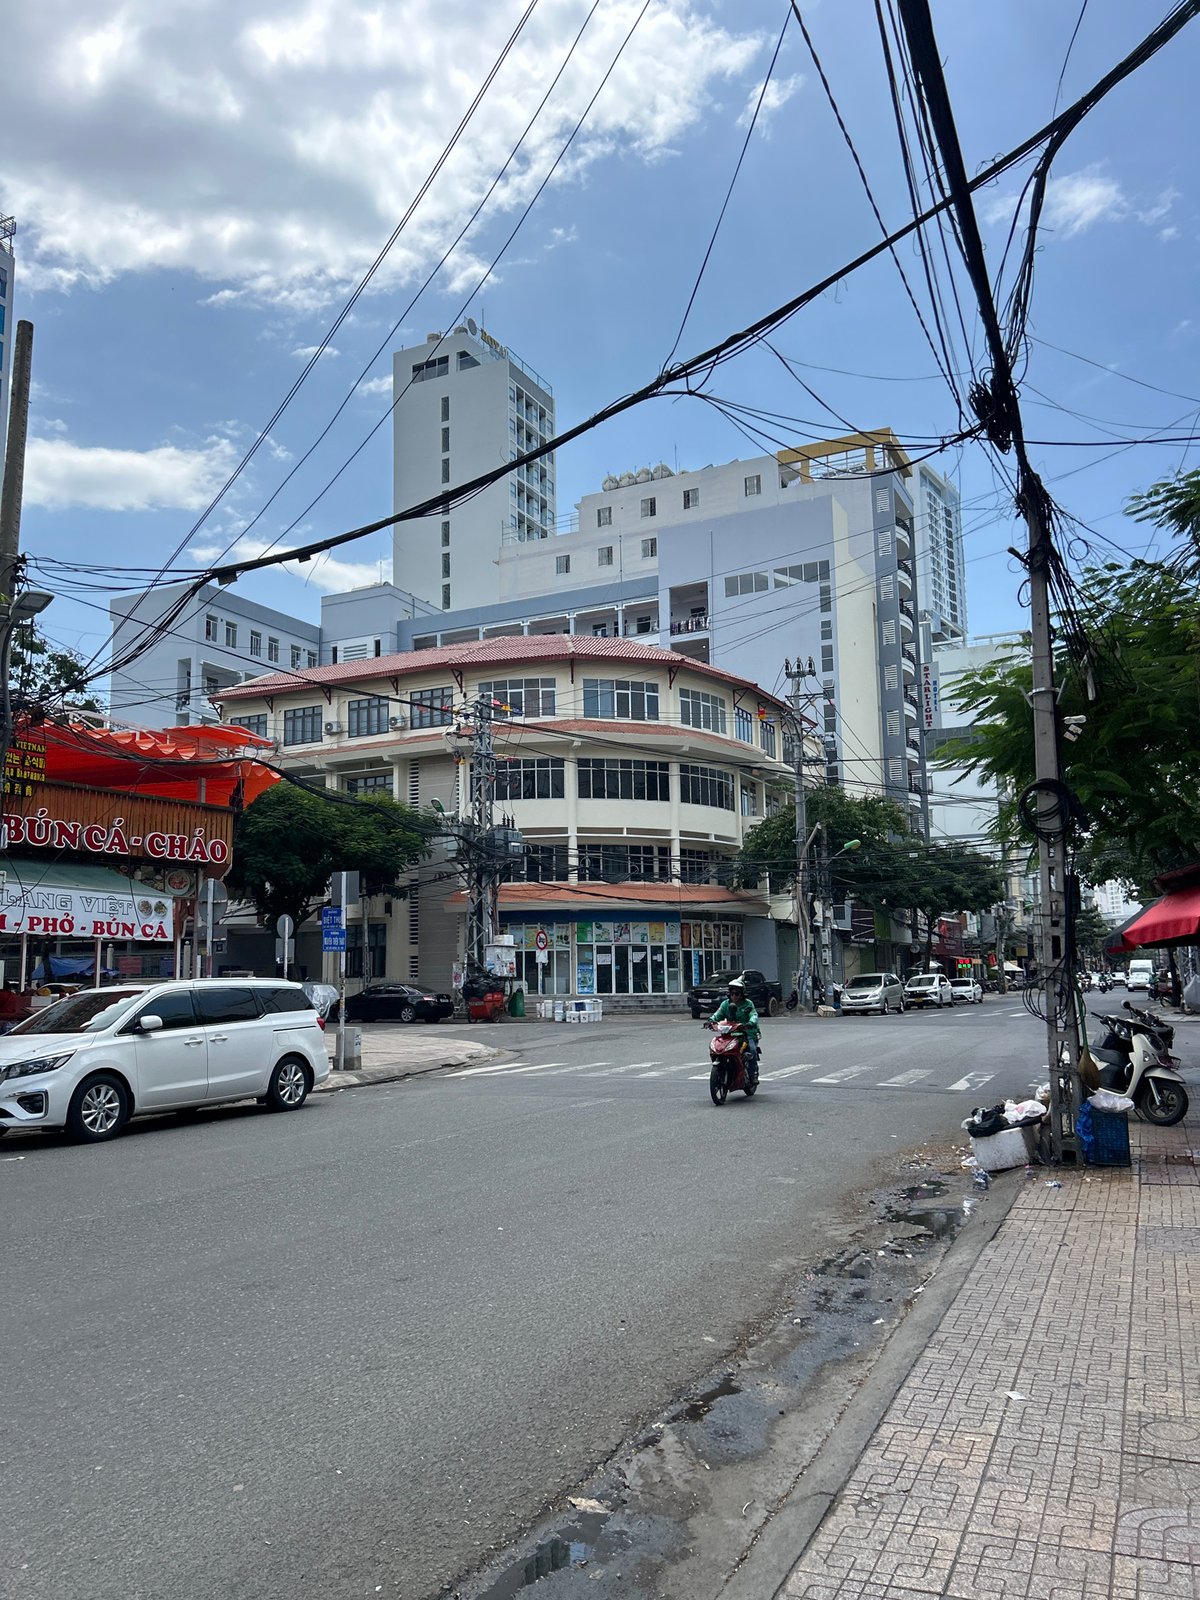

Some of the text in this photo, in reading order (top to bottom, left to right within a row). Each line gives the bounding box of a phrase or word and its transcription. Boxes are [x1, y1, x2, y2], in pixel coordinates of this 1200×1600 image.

[923, 665, 933, 727] STARLIGHT
[3, 807, 81, 849] BÚN
[83, 817, 130, 854] CÁ
[146, 828, 228, 863] CHÁO
[27, 912, 75, 933] PHỞ
[92, 917, 136, 936] BÚN
[140, 921, 168, 939] CÁ
[80, 895, 134, 917] VIỆT
